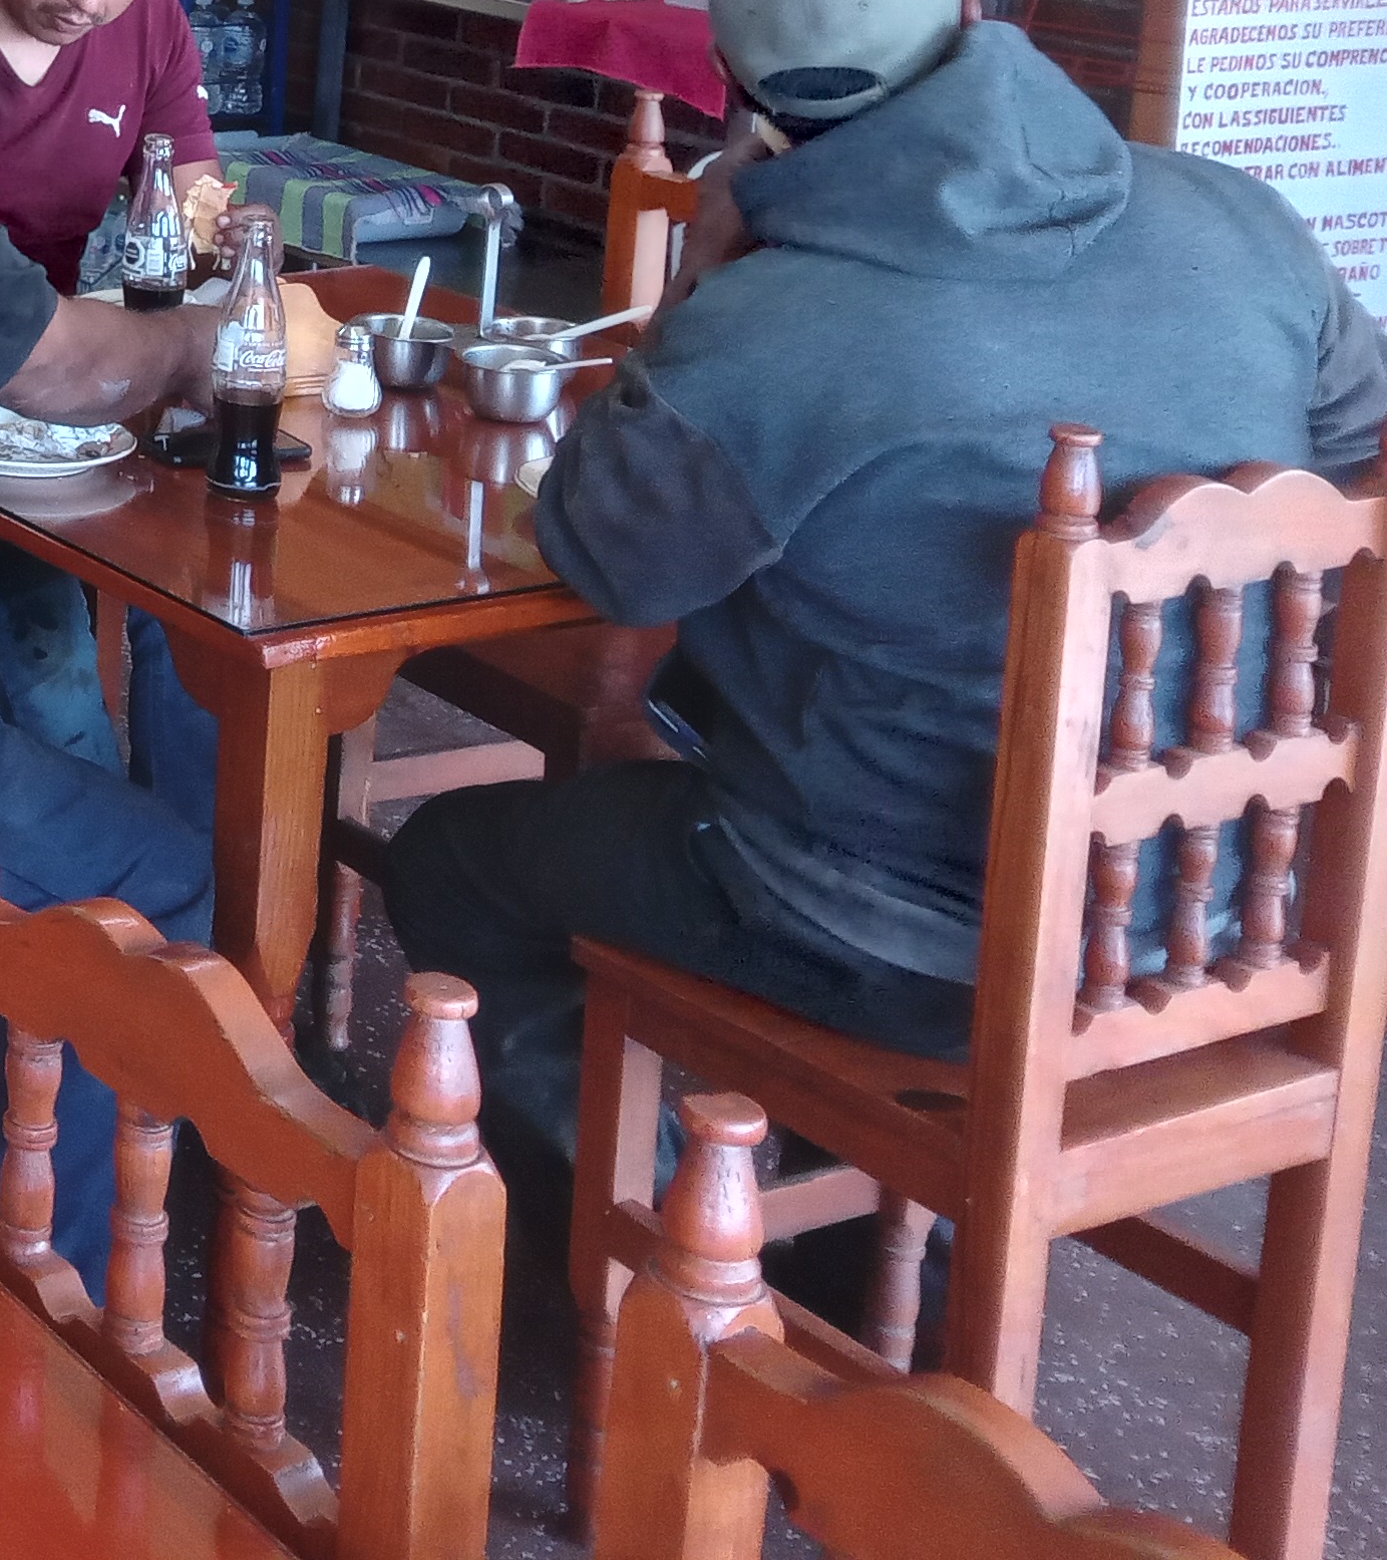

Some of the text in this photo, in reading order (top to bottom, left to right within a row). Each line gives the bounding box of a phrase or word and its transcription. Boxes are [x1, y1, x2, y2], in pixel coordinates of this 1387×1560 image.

[1189, 23, 1299, 47] AGRADECEMOS
[1301, 21, 1323, 40] SU
[1187, 51, 1302, 74] LE PEDIMOS SU
[1187, 85, 1197, 102] Y
[1182, 110, 1214, 130] CON
[1287, 161, 1320, 181] CON
[1331, 238, 1375, 258] SOBRE
